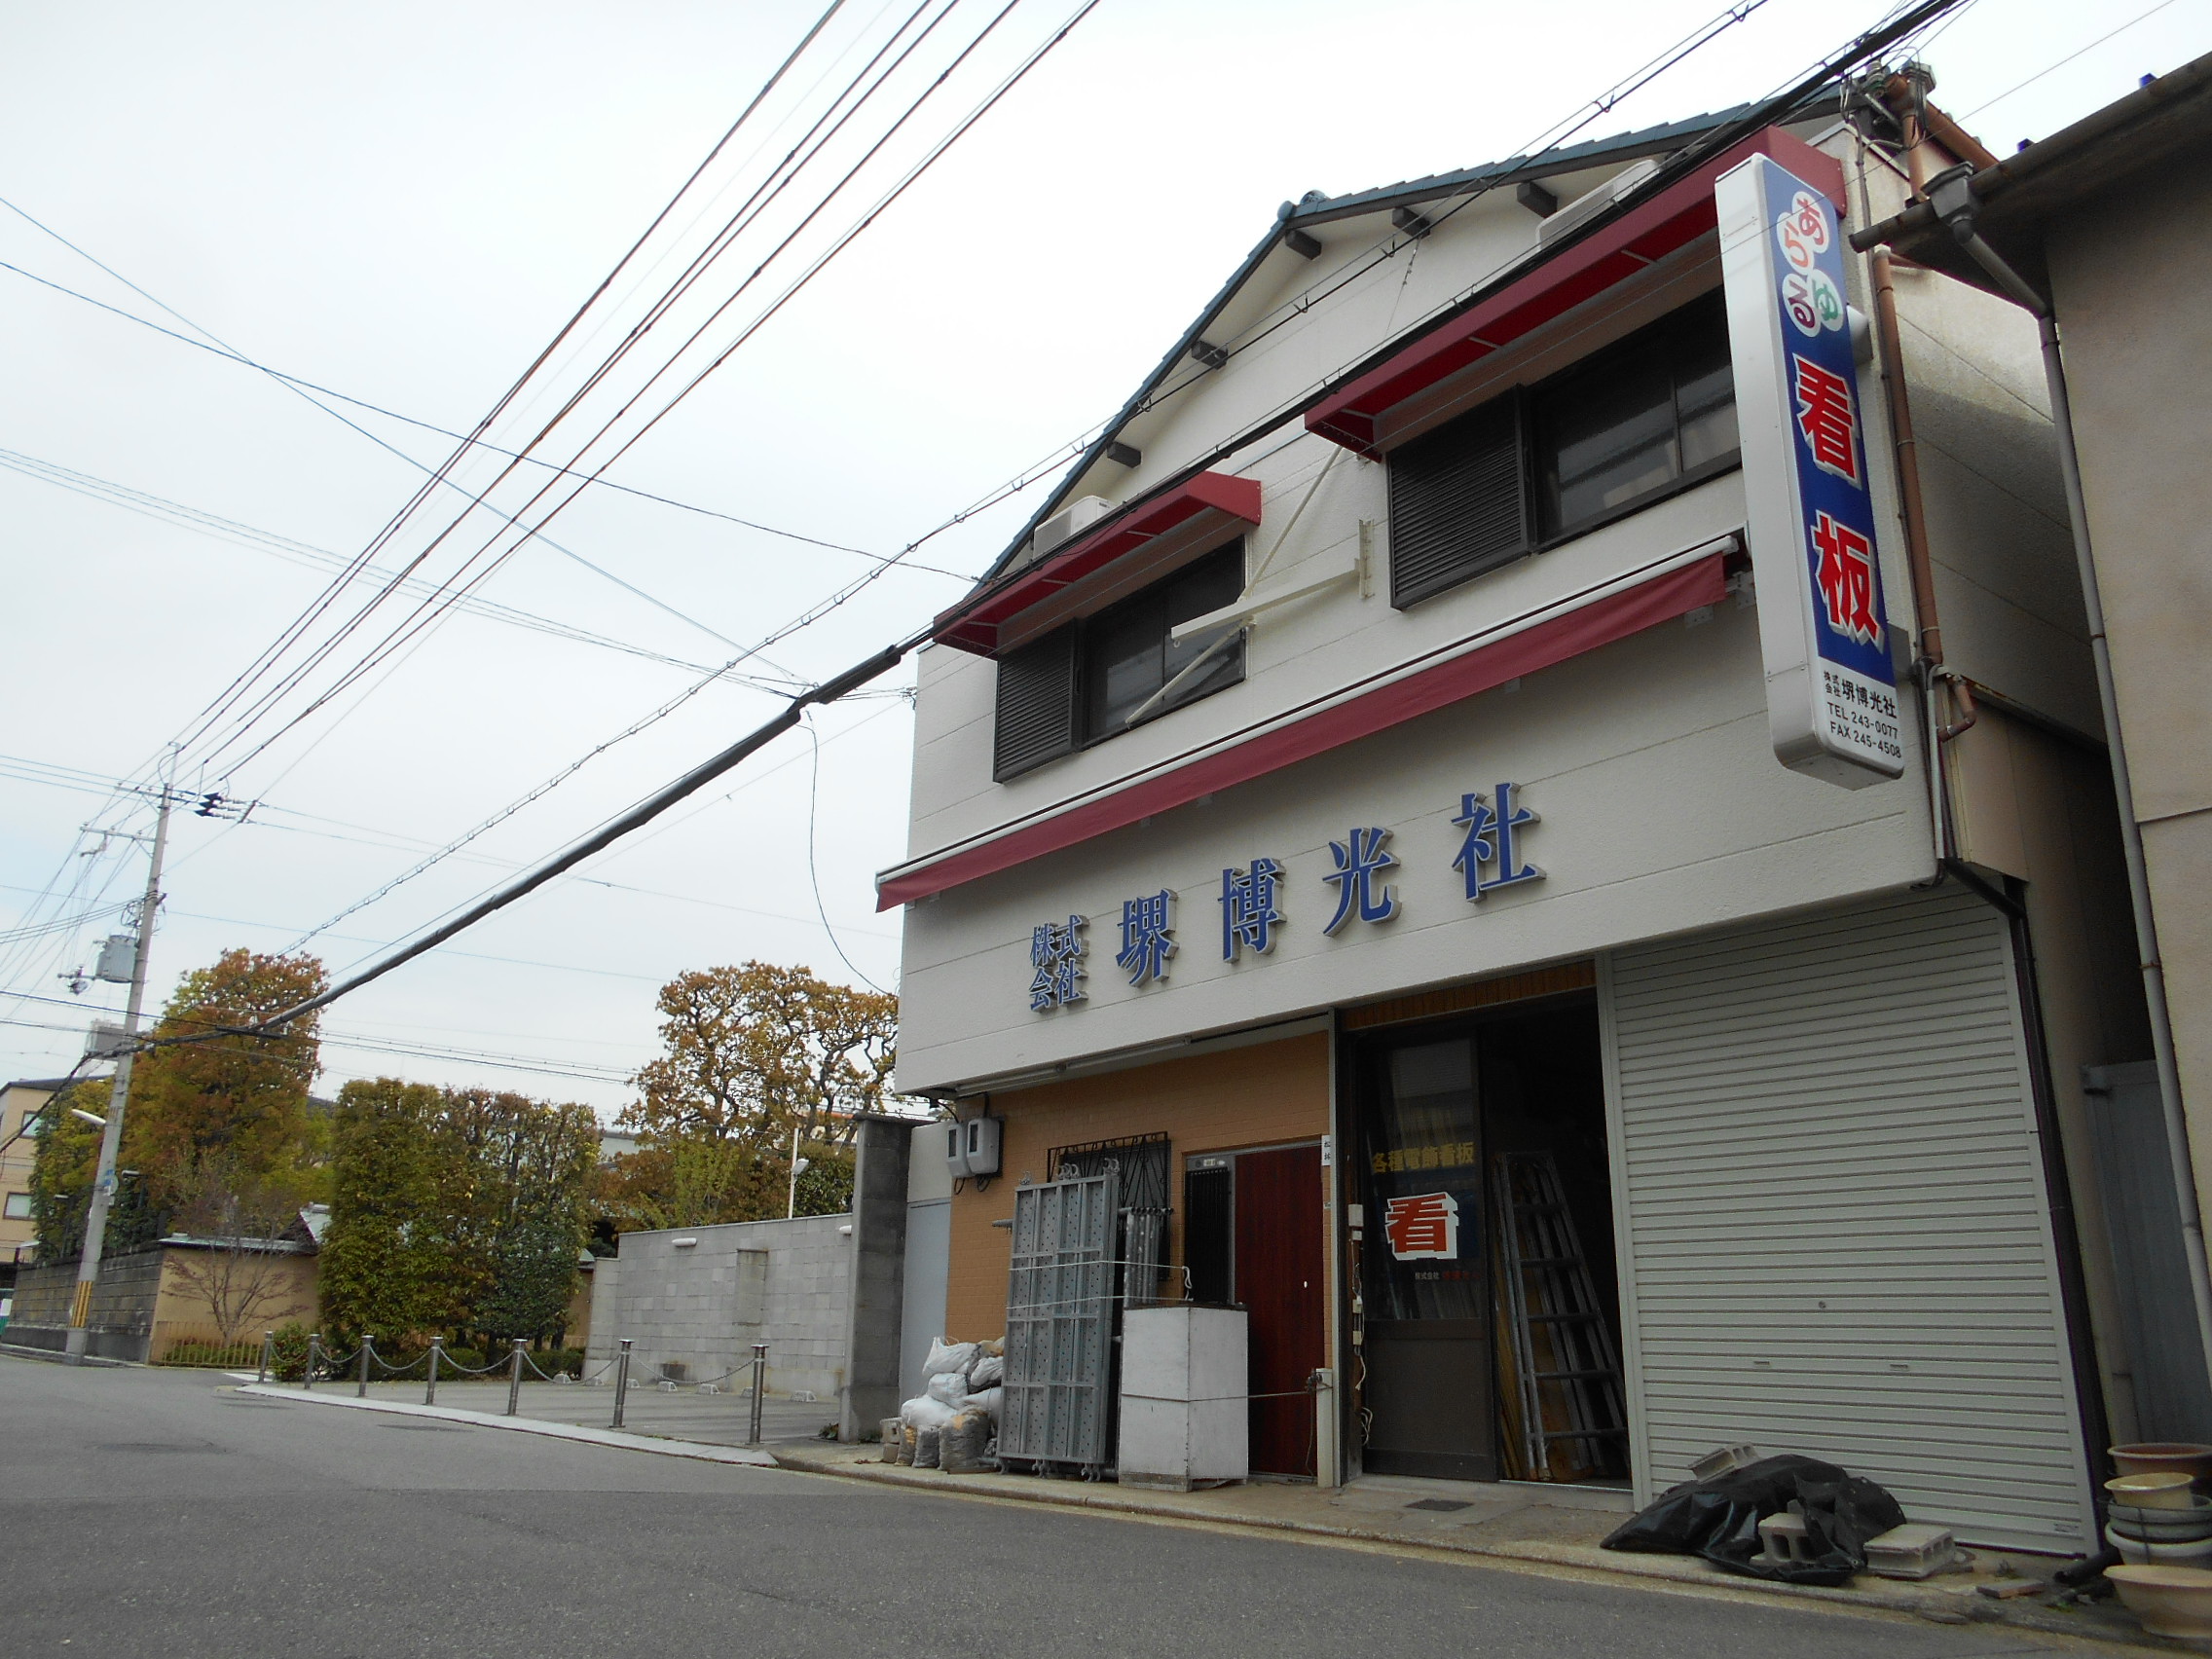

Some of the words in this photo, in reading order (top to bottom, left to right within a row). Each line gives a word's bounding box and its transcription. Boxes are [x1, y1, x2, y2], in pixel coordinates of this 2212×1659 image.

[1793, 351, 1885, 654] 看板
[1827, 702, 1849, 720] TEL
[1851, 711, 1898, 739] 243-0077
[1841, 679, 1898, 719] 堺博光社
[1830, 721, 1852, 739] FAX
[1854, 730, 1901, 758] 245-4508
[1116, 782, 1546, 987] 堺博光社
[1385, 1192, 1459, 1261] 看
